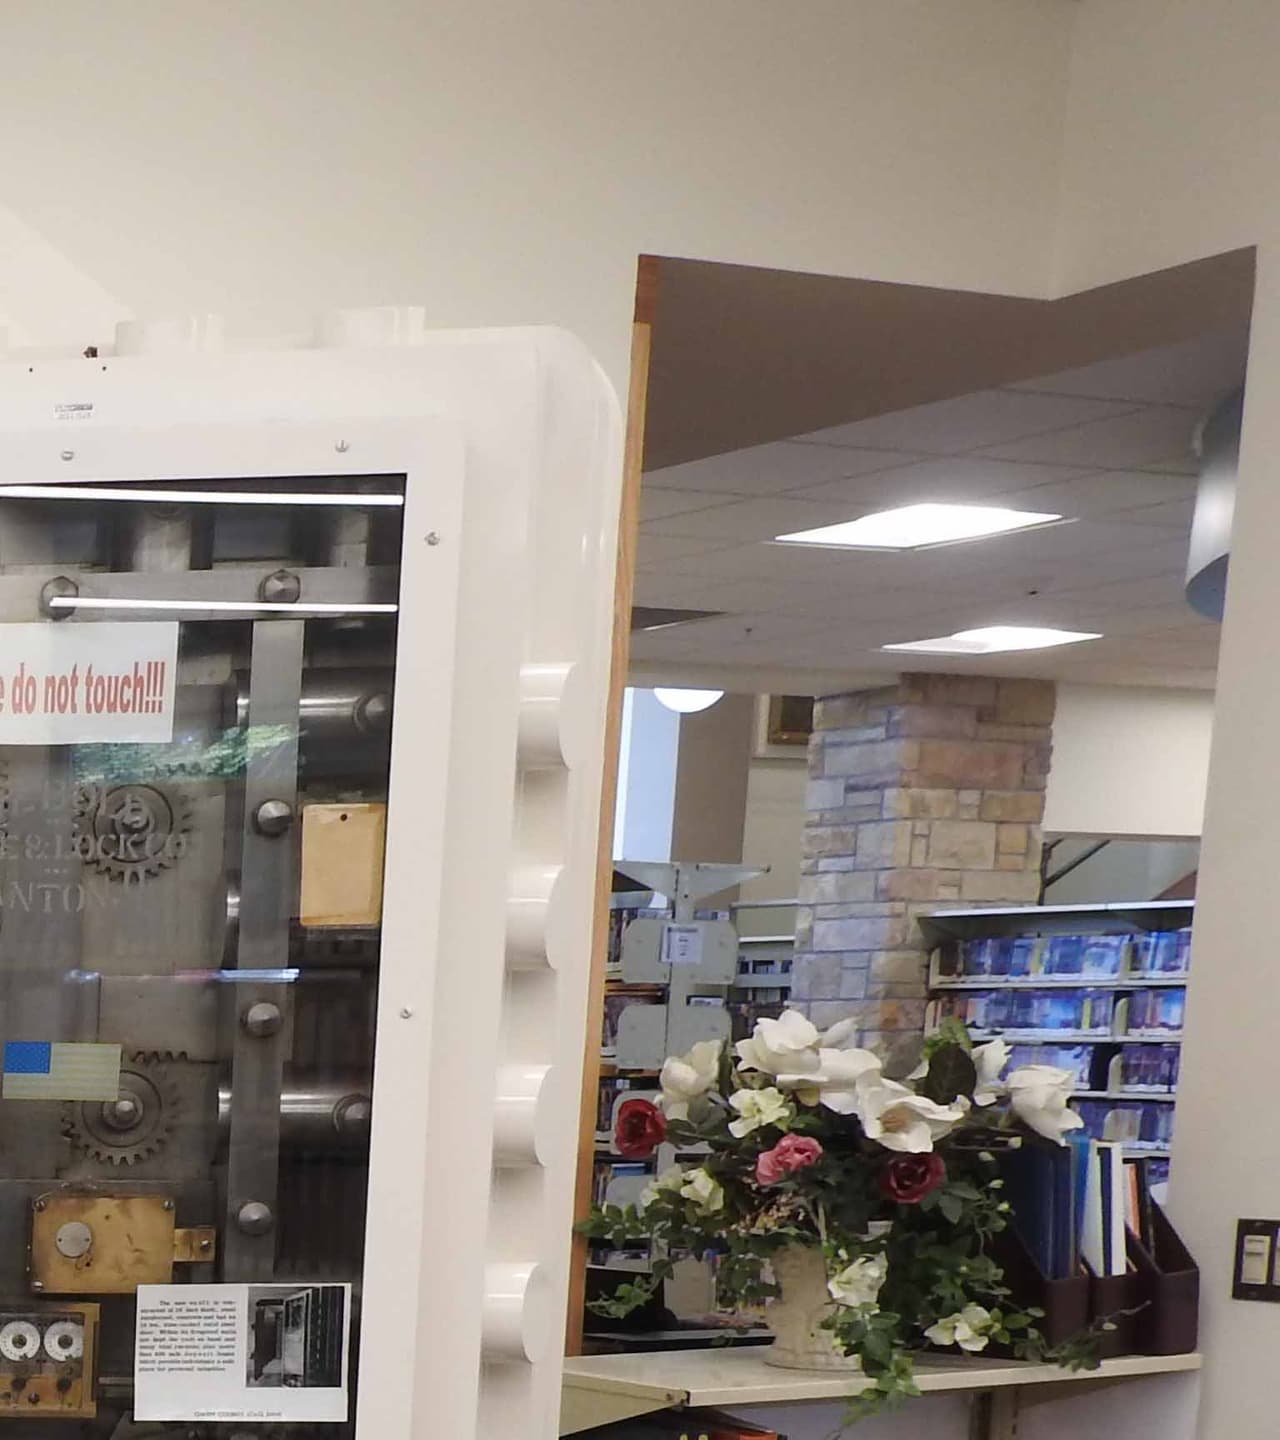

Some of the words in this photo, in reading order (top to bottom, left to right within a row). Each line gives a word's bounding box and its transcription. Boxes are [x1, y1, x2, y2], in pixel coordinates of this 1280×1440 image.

[11, 662, 37, 714] do
[44, 663, 79, 714] not
[85, 662, 166, 713] touch!!!
